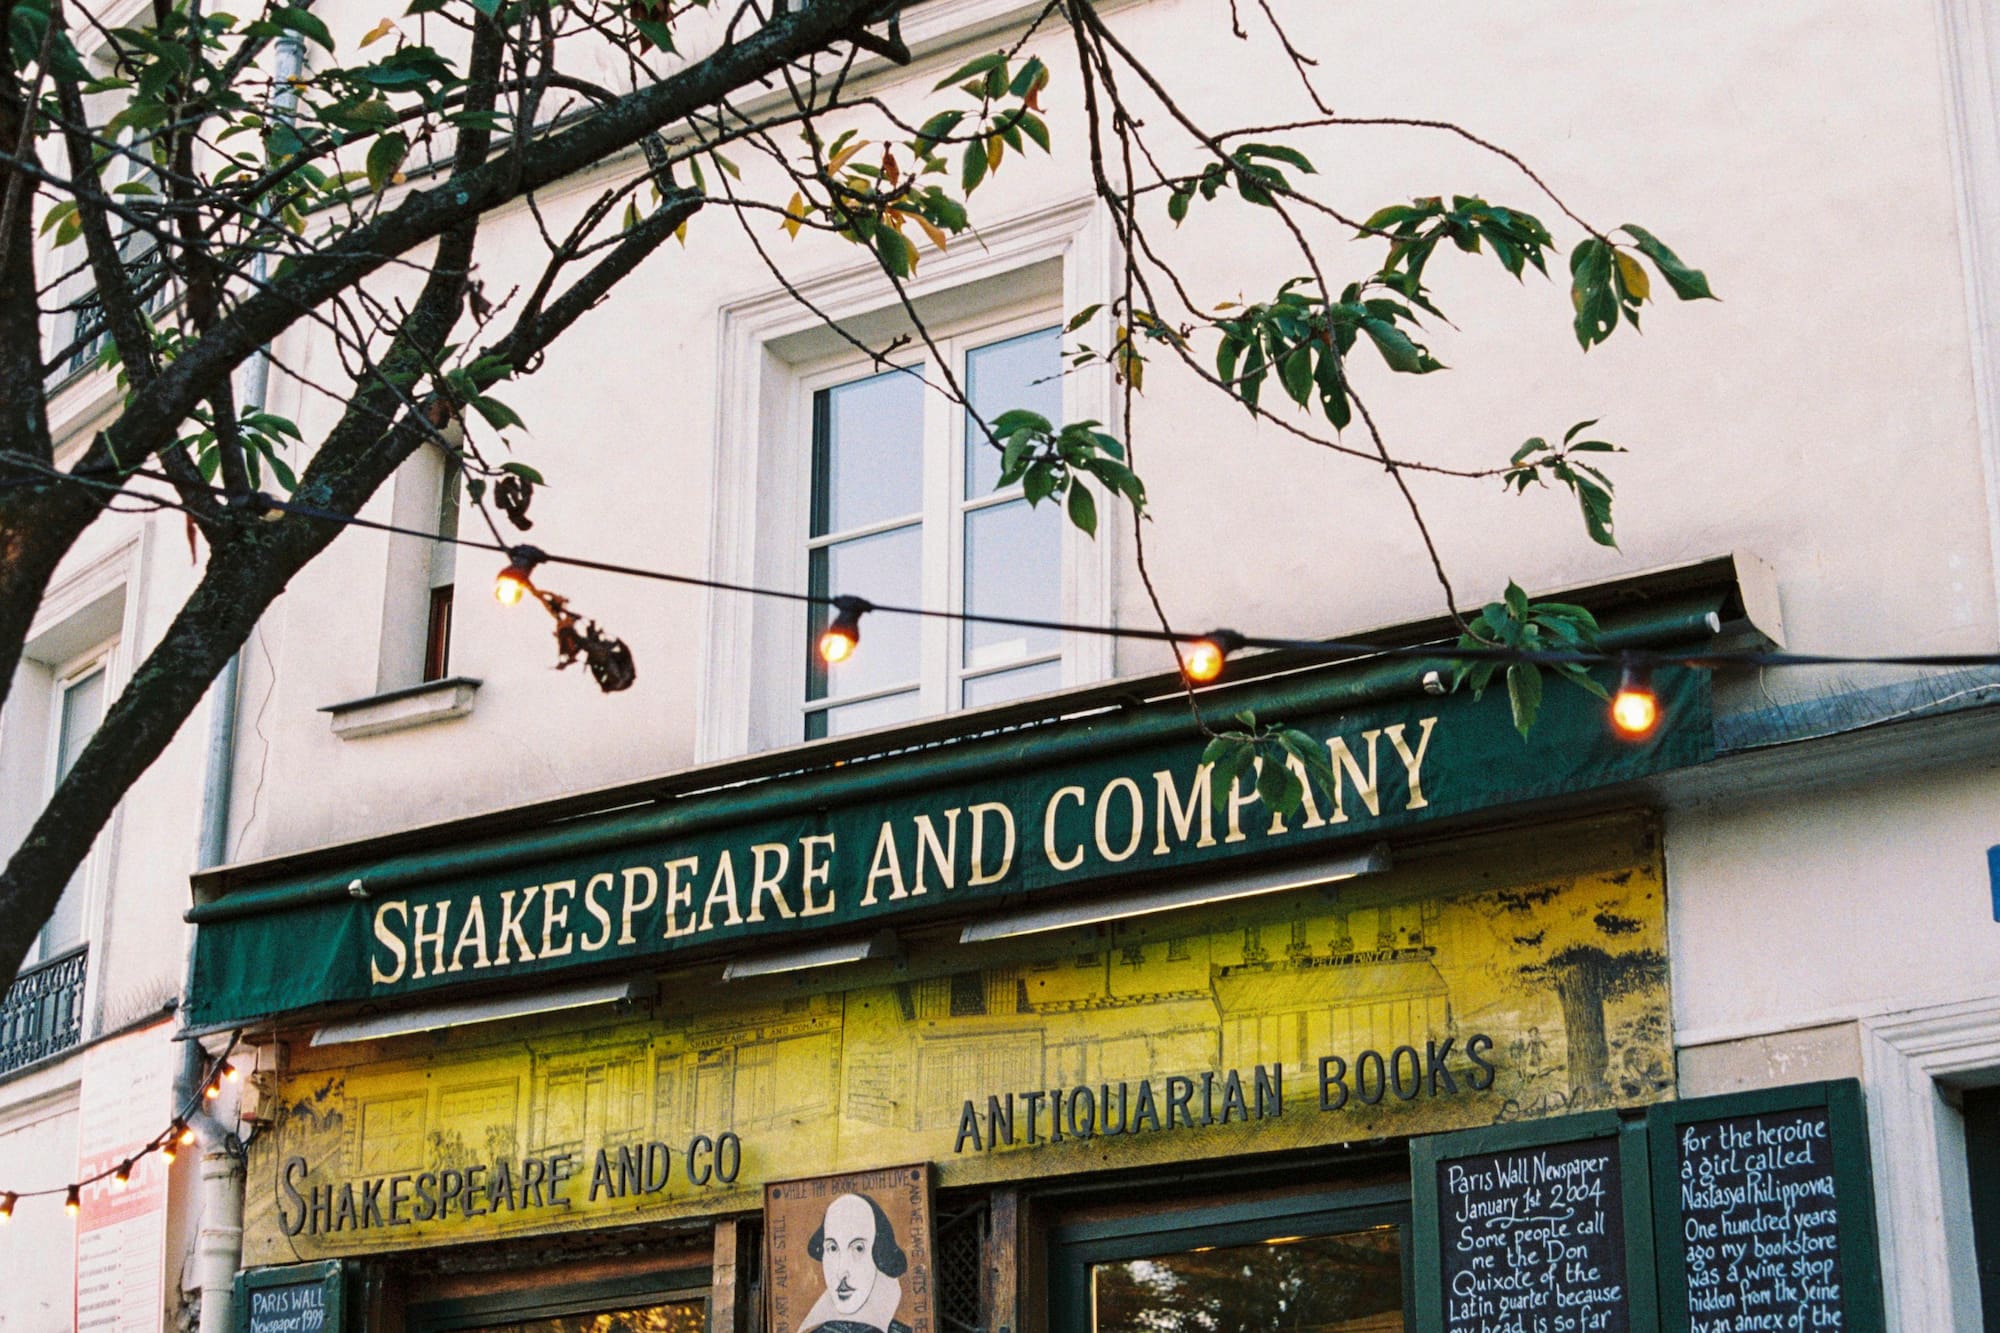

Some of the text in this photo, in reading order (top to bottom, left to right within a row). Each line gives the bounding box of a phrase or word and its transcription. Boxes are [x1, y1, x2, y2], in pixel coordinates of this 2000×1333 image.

[371, 717, 1437, 985] SHAKESPEARE AND COMPANY
[954, 1063, 1282, 1153] ANTIQUARIAN
[1318, 1034, 1495, 1111] BOOKS
[1683, 1119, 1826, 1157] for the heroine
[1448, 1152, 1609, 1194] Paris Wall Newspaper
[1681, 1140, 1815, 1187] a girl called
[278, 1132, 740, 1237] SHAKESPEARE AND CO
[1456, 1178, 1606, 1229] January 1st 2004
[1681, 1178, 1745, 1214] Nastasya
[774, 1215, 786, 1248] STILL
[1457, 1211, 1605, 1251] Some people call
[1685, 1206, 1837, 1242] One hundred years
[1472, 1240, 1588, 1270] me the Don
[1686, 1232, 1837, 1271] ago my bookstore
[1452, 1262, 1601, 1298] Quixote of the
[1688, 1256, 1833, 1288] was a wine shop
[253, 1287, 325, 1314] PARIS WALL
[1450, 1283, 1622, 1322] Latin quarter because
[1688, 1276, 1840, 1315] hidden from the Seine
[1482, 1313, 1526, 1333] head
[1534, 1314, 1547, 1333] is
[1554, 1315, 1575, 1332] so
[1580, 1305, 1612, 1333] far
[1712, 1317, 1731, 1333] an
[1735, 1313, 1783, 1332] annex
[1788, 1304, 1808, 1333] of
[1812, 1304, 1843, 1327] the
